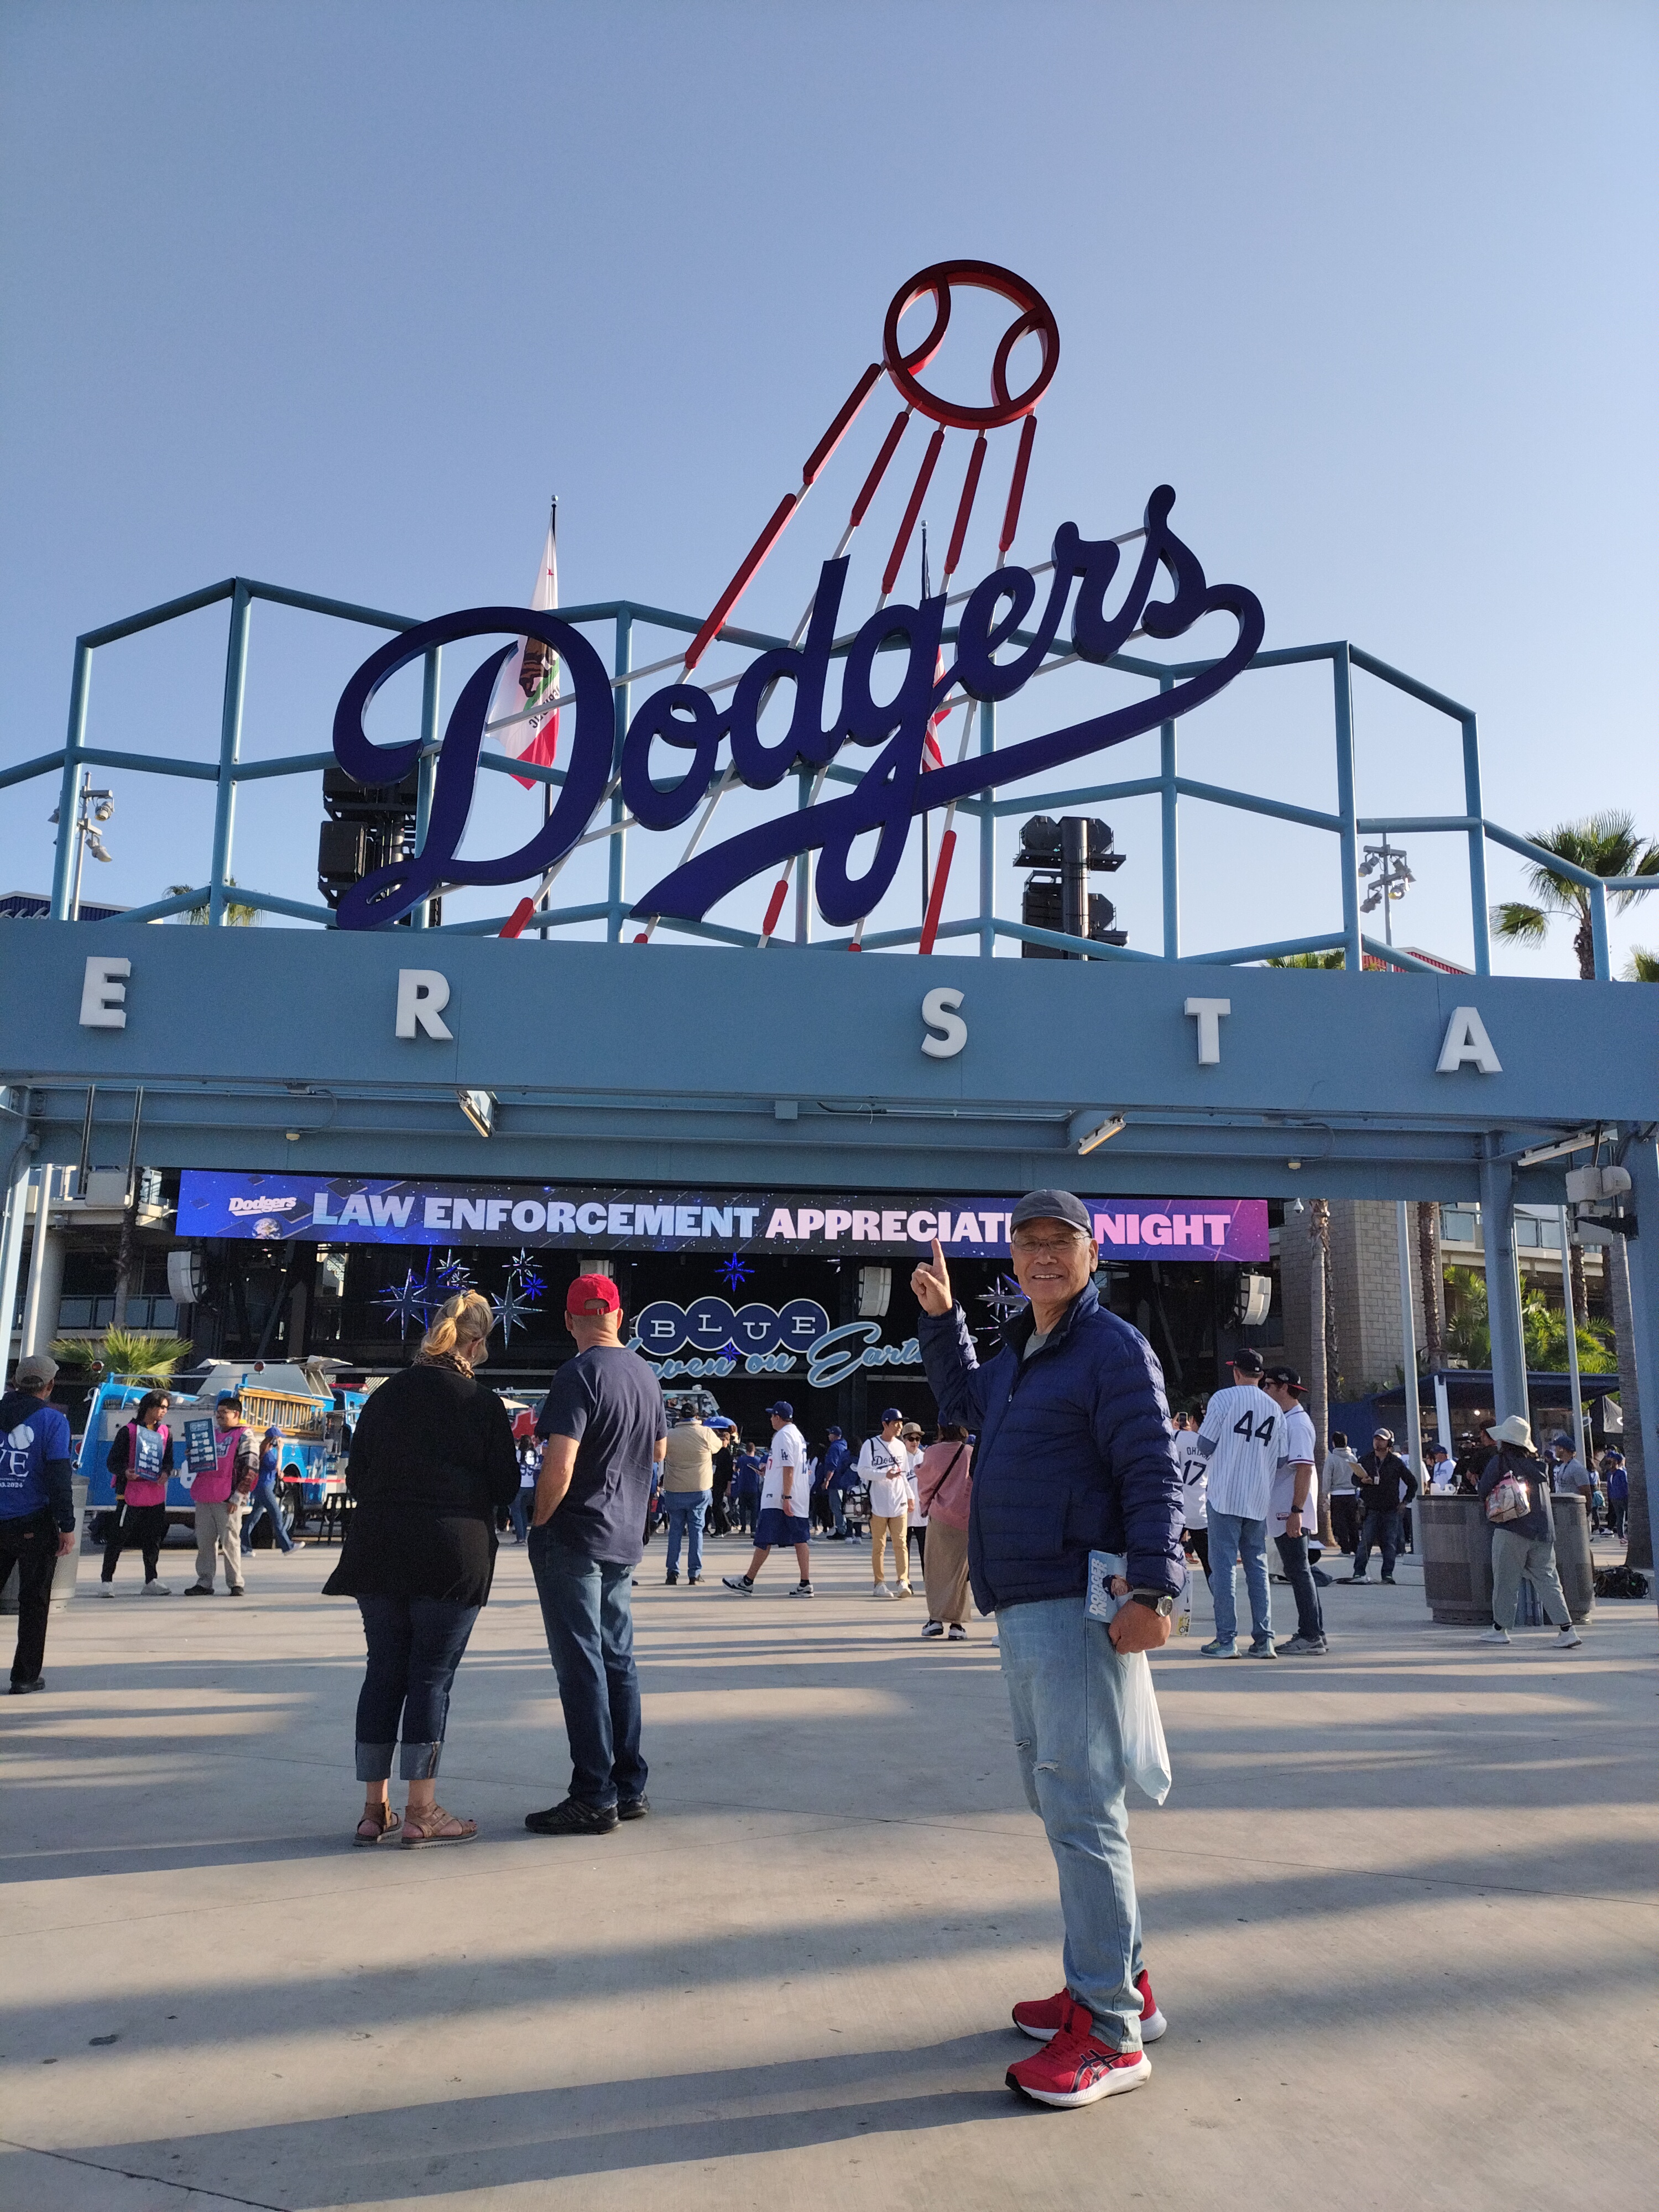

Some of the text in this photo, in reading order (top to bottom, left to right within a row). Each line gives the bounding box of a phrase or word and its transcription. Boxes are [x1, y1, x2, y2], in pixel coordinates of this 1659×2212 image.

[332, 485, 1265, 931] Dodgers
[228, 1196, 297, 1216] Dodgers
[312, 1193, 1231, 1245] LAW ENFORCEMENT APPRECIATI NIGHT
[650, 1314, 816, 1340] BLUE
[745, 1353, 797, 1375] on
[806, 1321, 923, 1389] Eart
[1234, 1410, 1275, 1447] 44
[1182, 1460, 1207, 1486] 17
